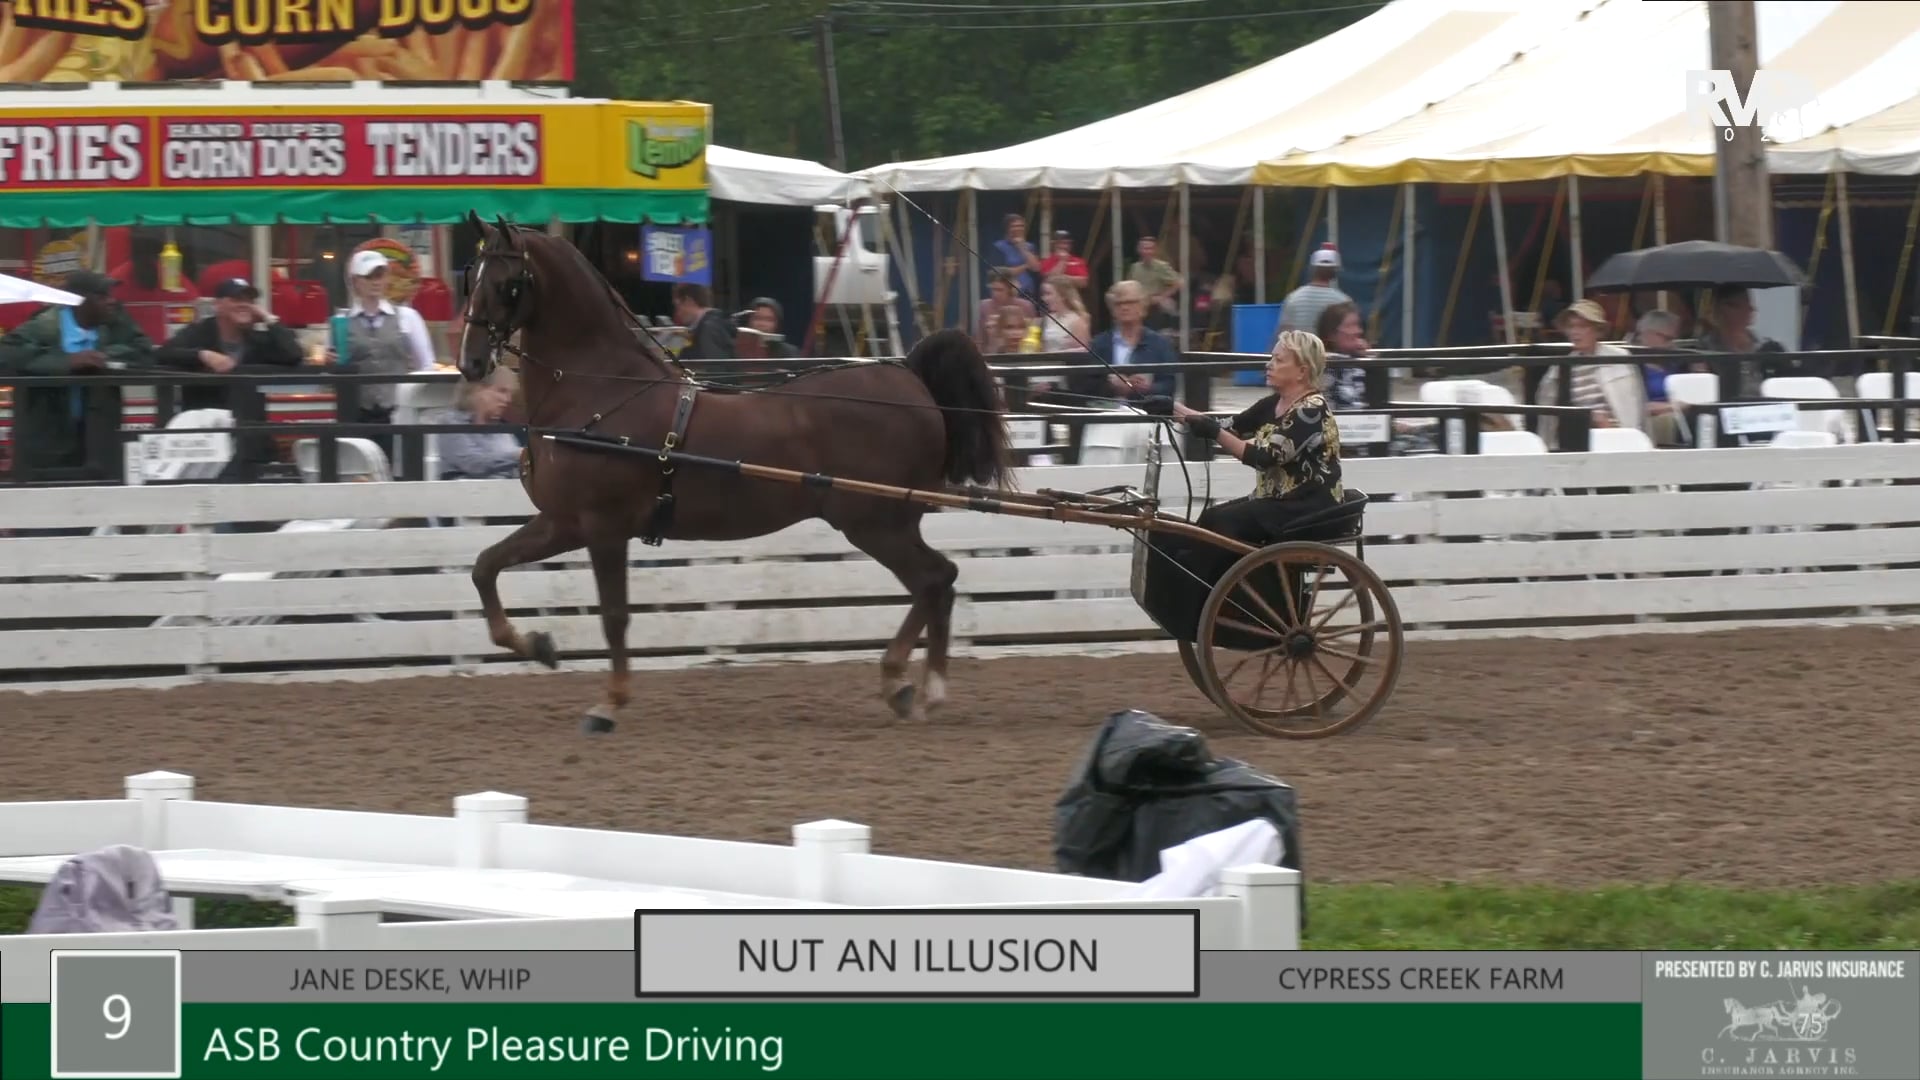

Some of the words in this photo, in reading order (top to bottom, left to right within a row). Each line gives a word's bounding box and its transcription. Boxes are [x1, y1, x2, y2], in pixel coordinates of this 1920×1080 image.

[195, 0, 356, 35] CORN
[167, 124, 244, 138] HAND
[365, 122, 538, 177] TENDERS
[163, 140, 254, 179] CORN
[257, 138, 346, 177] DOGS
